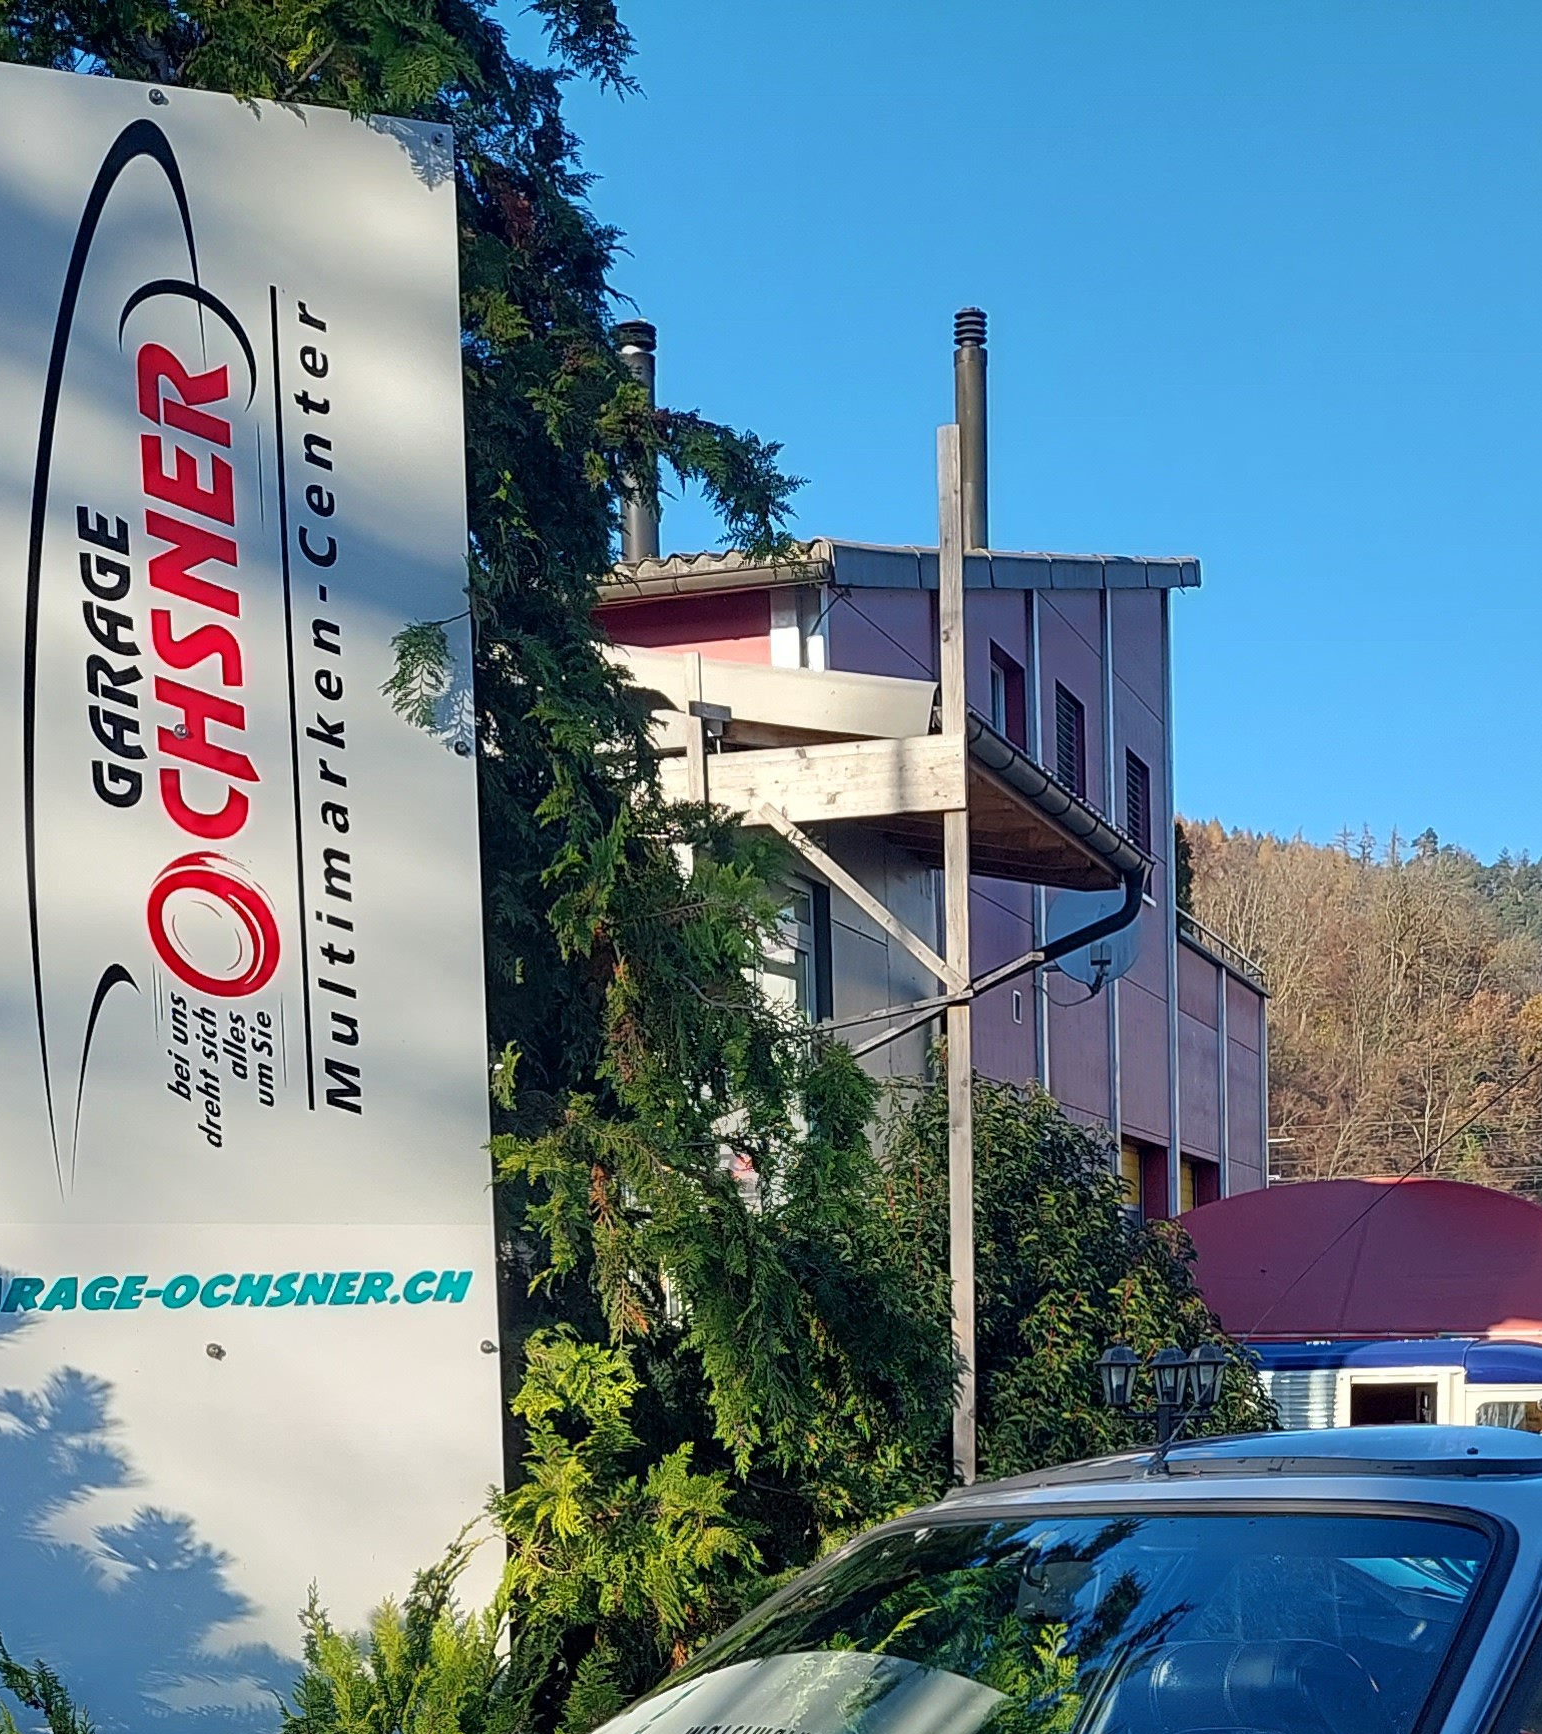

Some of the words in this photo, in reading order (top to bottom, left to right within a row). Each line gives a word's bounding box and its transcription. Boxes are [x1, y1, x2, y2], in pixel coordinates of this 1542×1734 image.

[76, 504, 148, 808] GARAGE
[136, 341, 281, 998] OCHSNER
[296, 301, 363, 1115] Multimarken-Center
[170, 991, 189, 1046] uns
[192, 1006, 219, 1064] sich
[222, 1010, 248, 1080] alles
[250, 1011, 273, 1058] Sie
[167, 1049, 192, 1102] bei
[258, 1063, 275, 1108] um
[195, 1068, 223, 1148] dreht
